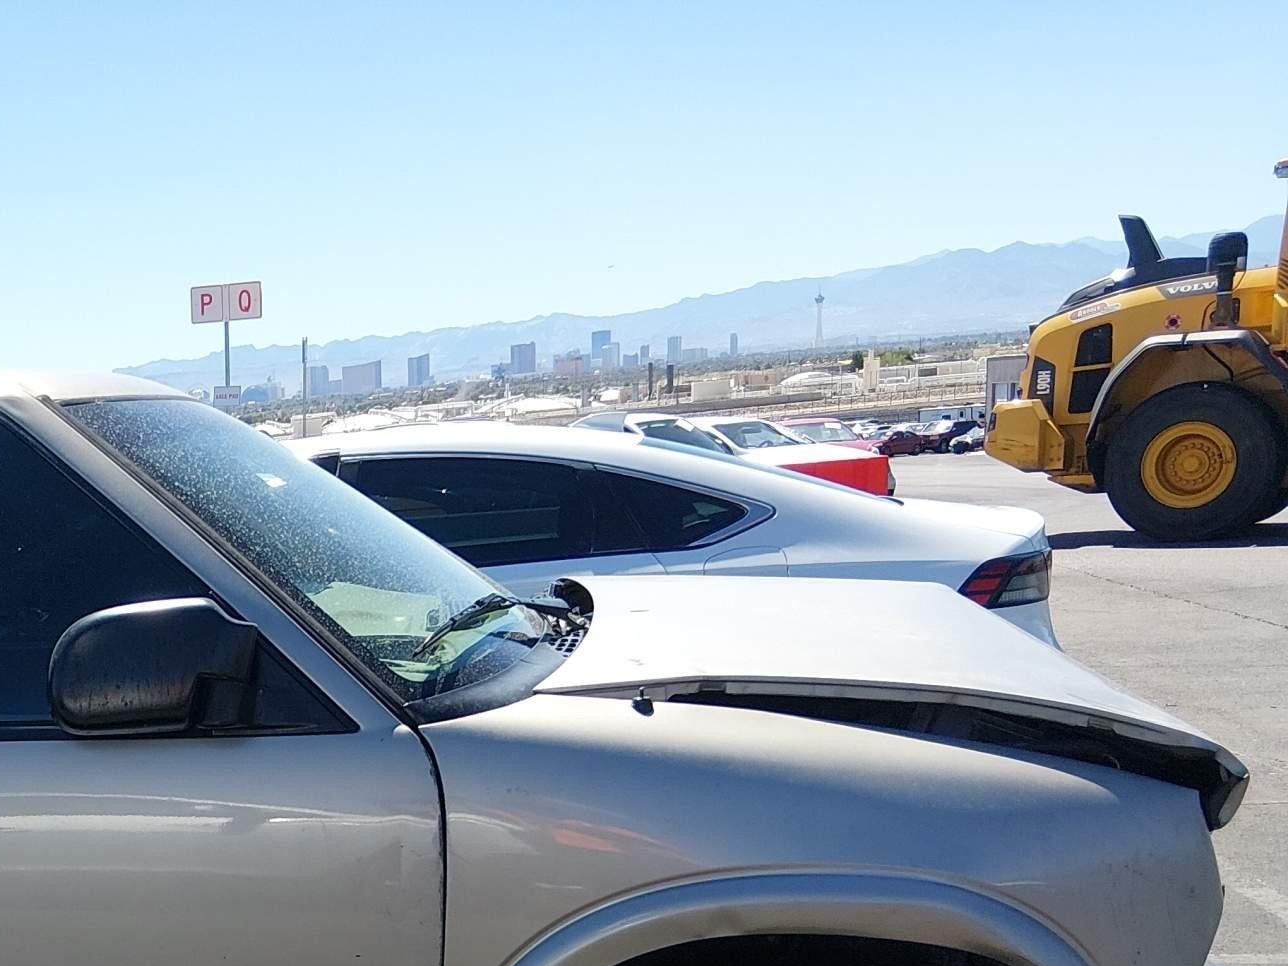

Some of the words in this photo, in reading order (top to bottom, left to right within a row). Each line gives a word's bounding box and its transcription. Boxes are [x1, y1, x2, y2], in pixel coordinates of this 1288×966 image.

[1167, 279, 1218, 294] VOLV
[200, 293, 213, 316] P
[238, 289, 251, 312] Q
[1036, 370, 1051, 395] L90H
